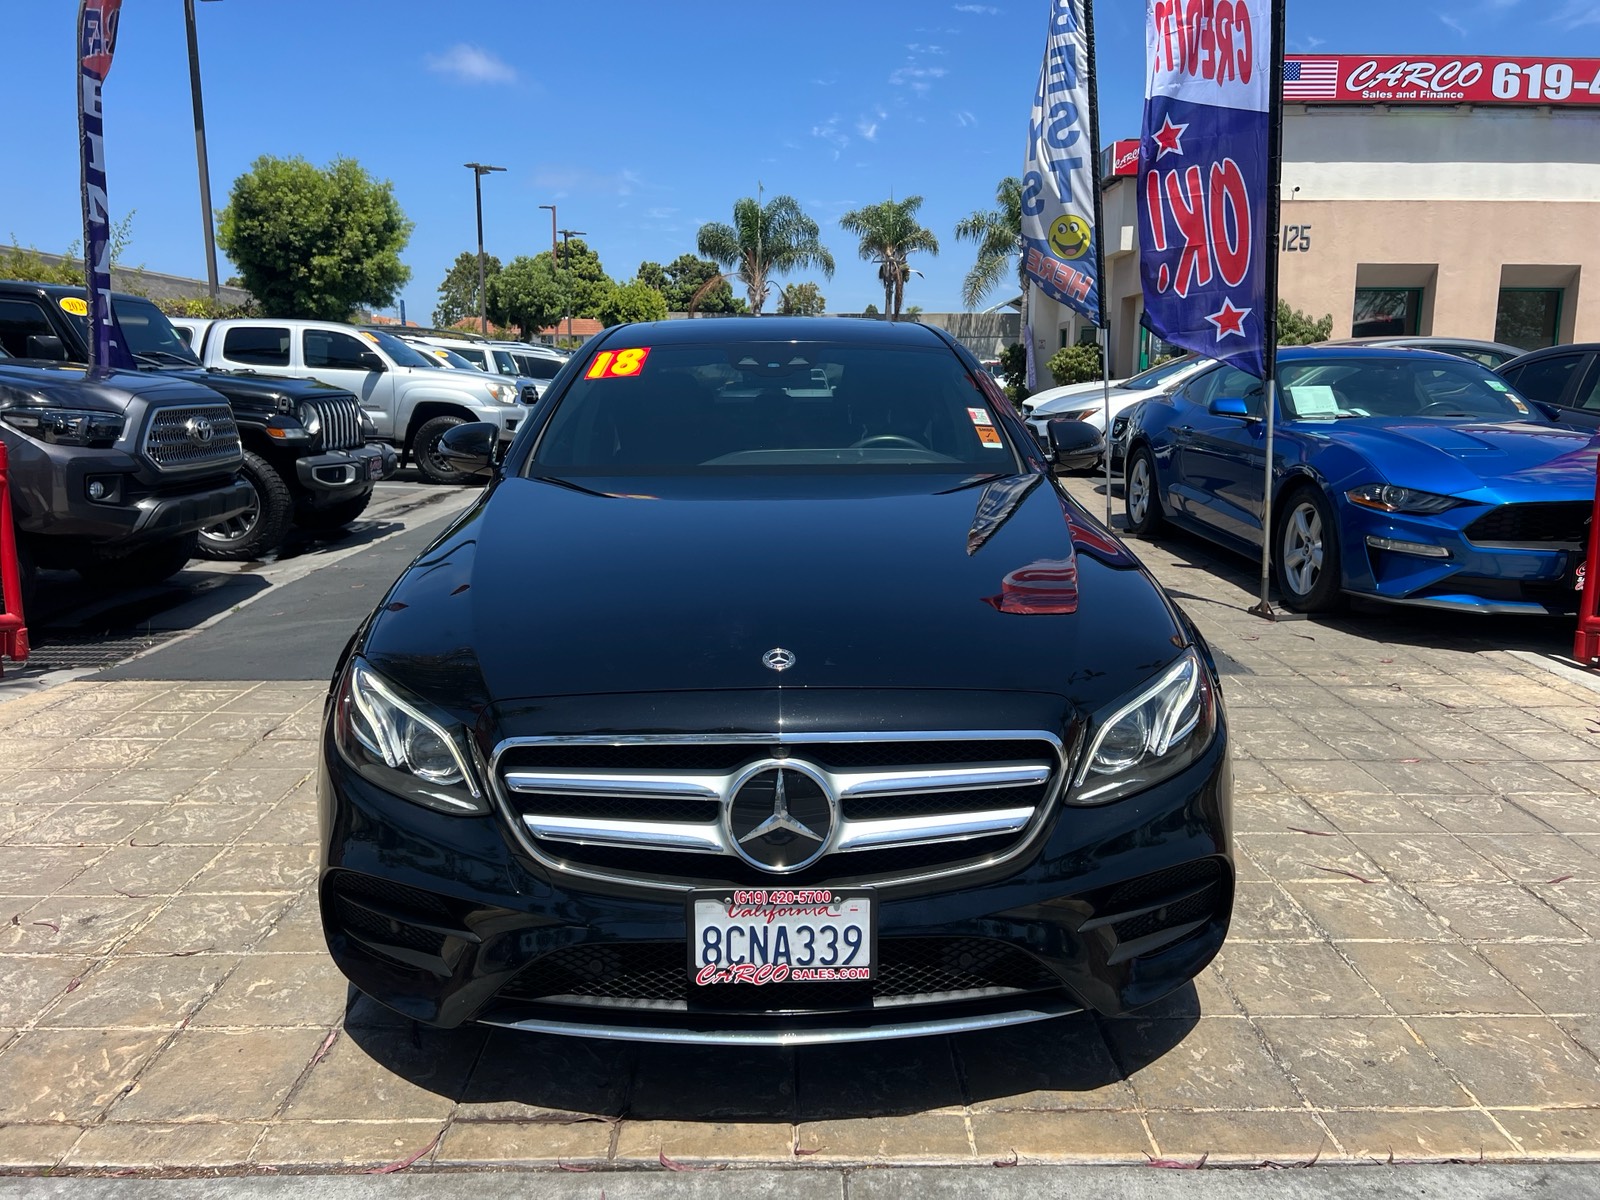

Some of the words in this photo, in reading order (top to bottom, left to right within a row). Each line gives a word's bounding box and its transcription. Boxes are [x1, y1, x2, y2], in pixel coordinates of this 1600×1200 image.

[1345, 60, 1484, 92] CARCO
[1362, 89, 1393, 99] Sales
[1396, 89, 1416, 99] and
[1420, 90, 1464, 99] Finance
[1115, 147, 1140, 168] CARC
[588, 348, 647, 378] 18
[734, 890, 768, 905] (619)
[769, 890, 832, 904] 420-5700
[728, 902, 842, 924] California
[702, 925, 863, 966] 8CNA339
[696, 962, 790, 986] CARCO
[792, 968, 870, 980] SALES.COM
